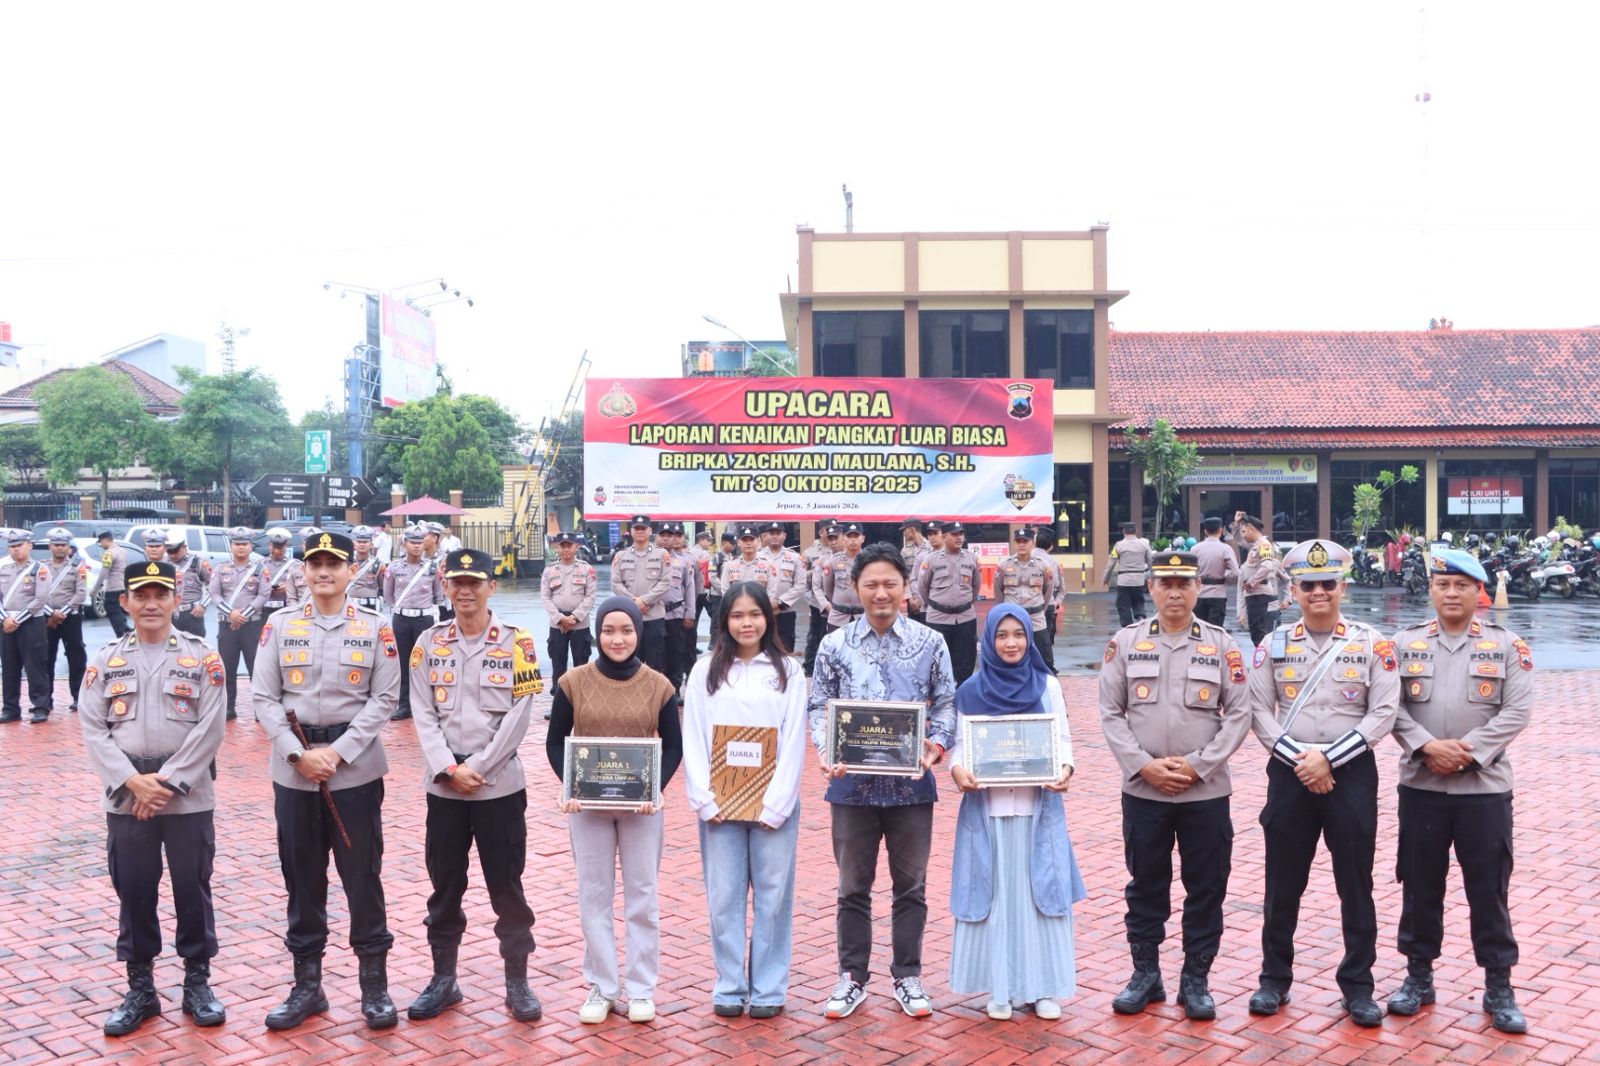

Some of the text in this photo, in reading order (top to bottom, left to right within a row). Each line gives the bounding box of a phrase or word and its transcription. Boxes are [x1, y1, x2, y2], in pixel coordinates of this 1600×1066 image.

[745, 391, 893, 418] UPACARA
[630, 424, 1007, 446] LAPORAN KENAIKAN PANGKAT LUAR BIASA
[659, 452, 975, 473] BRIPKA ZACHWAN MAULANA, S.H.
[711, 474, 921, 493] TMT 30 OKTOBER 2025
[283, 639, 310, 647] ERICK
[343, 640, 372, 648] POLRI
[1127, 653, 1160, 661] KARMAN
[1335, 656, 1367, 664] POLRI
[1403, 652, 1433, 660] ANDI
[1470, 652, 1504, 660] POLRI
[450, 659, 456, 667] S
[482, 659, 512, 669] POLRI
[1191, 656, 1219, 667] POLRI
[104, 669, 135, 680] SUTONO
[168, 669, 201, 680] POLRI
[859, 725, 886, 734] JUARA
[729, 750, 753, 758] JUARA
[595, 761, 623, 769] JUARA
